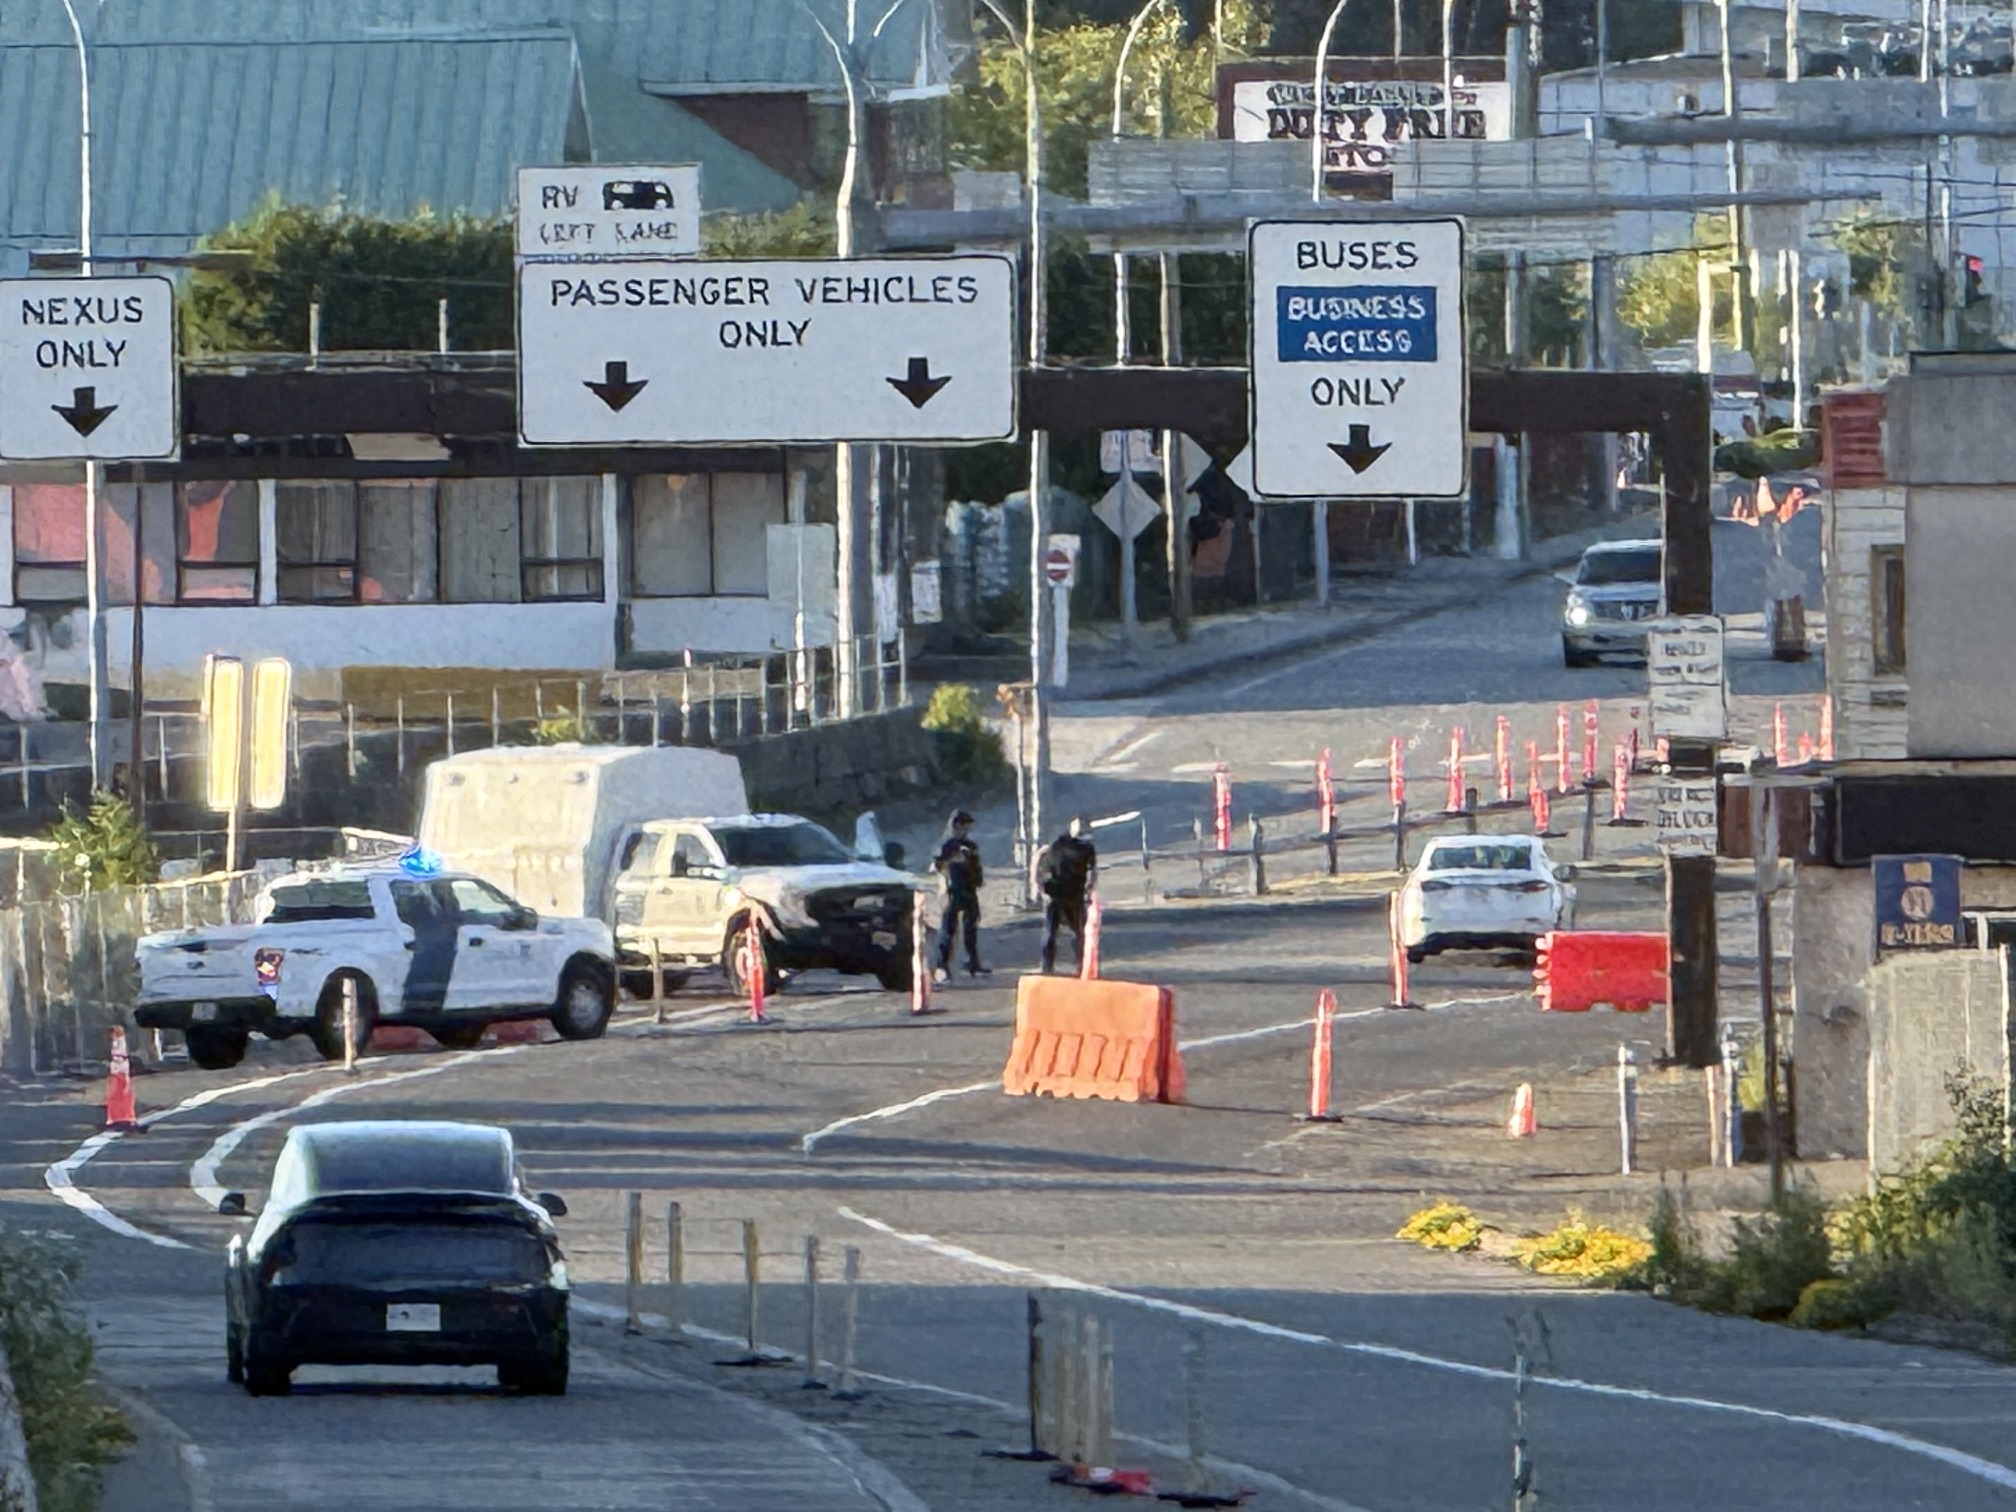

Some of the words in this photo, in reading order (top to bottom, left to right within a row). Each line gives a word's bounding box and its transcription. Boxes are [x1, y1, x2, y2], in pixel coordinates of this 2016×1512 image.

[541, 184, 579, 210] RV
[1296, 241, 1419, 270] BUSES
[551, 277, 770, 306] PASSENGER
[796, 275, 979, 305] VEHICLES
[22, 297, 144, 324] NEXUS
[1287, 293, 1426, 321] BUSINESS
[719, 319, 812, 349] ONLY
[1303, 330, 1413, 354] ACCESS
[35, 340, 127, 370] ONLY
[1310, 376, 1406, 406] ONLY
